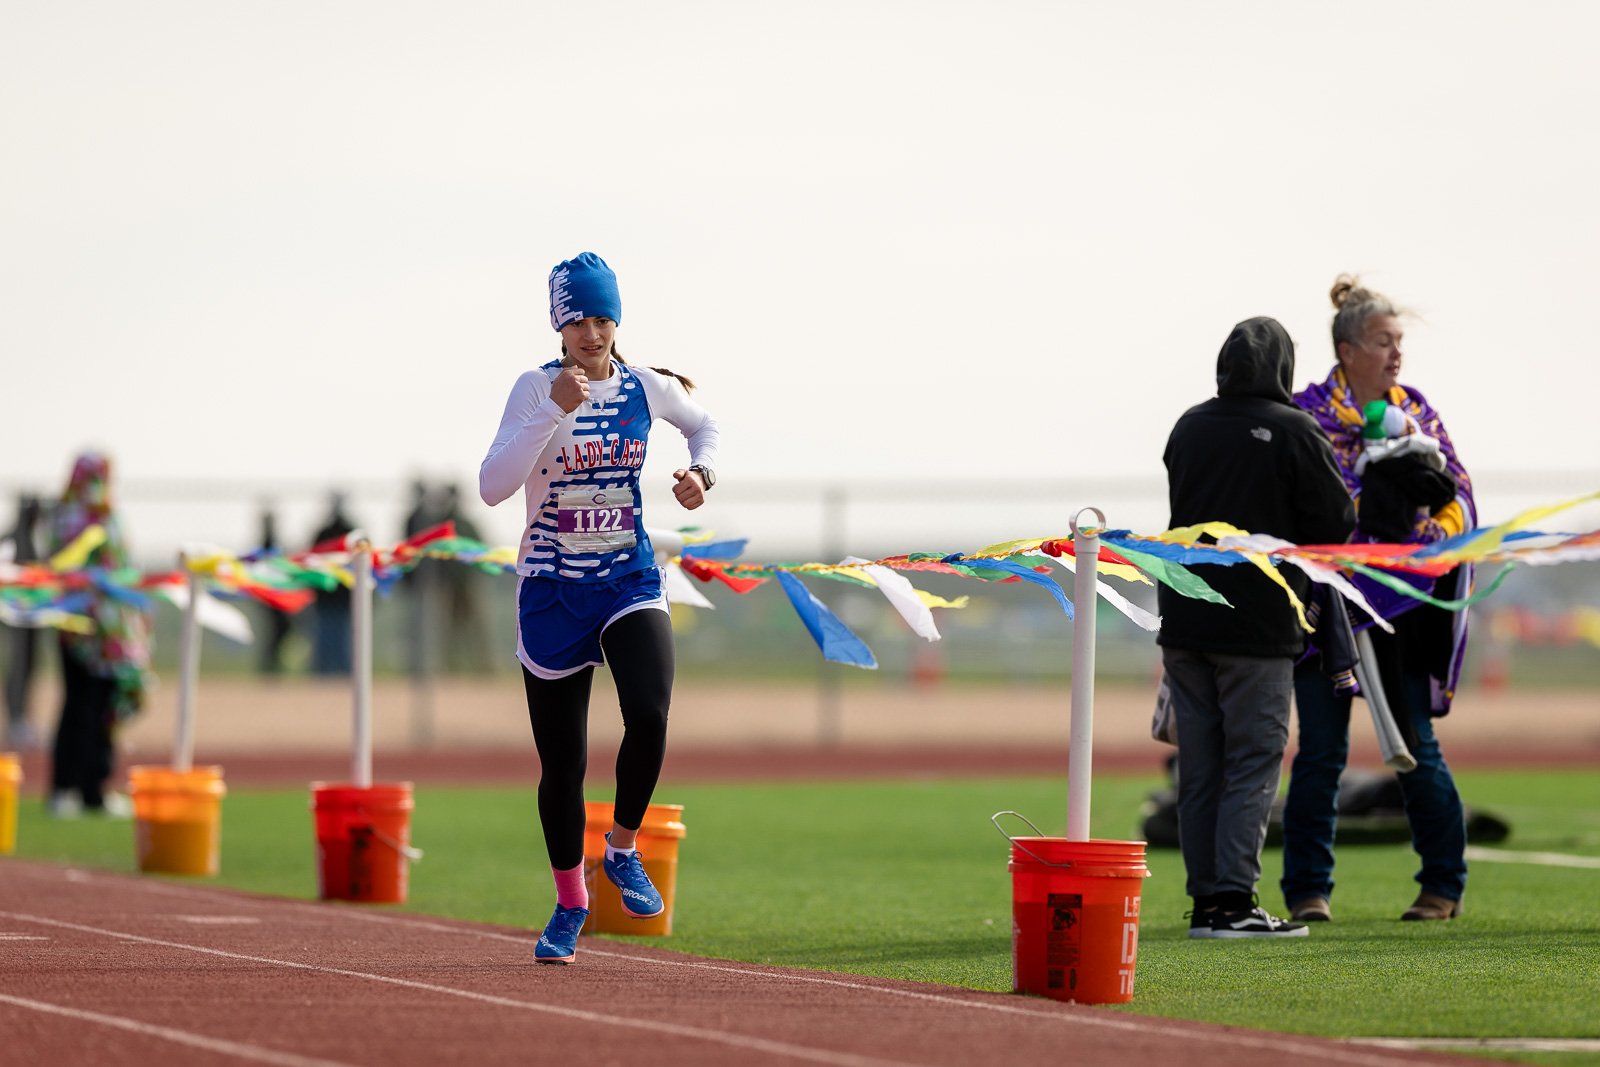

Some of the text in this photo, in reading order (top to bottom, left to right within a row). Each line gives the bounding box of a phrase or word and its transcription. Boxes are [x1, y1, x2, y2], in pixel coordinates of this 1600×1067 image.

[561, 438, 645, 473] LADY CATS
[573, 508, 622, 532] 1122
[622, 888, 656, 906] BROOKS
